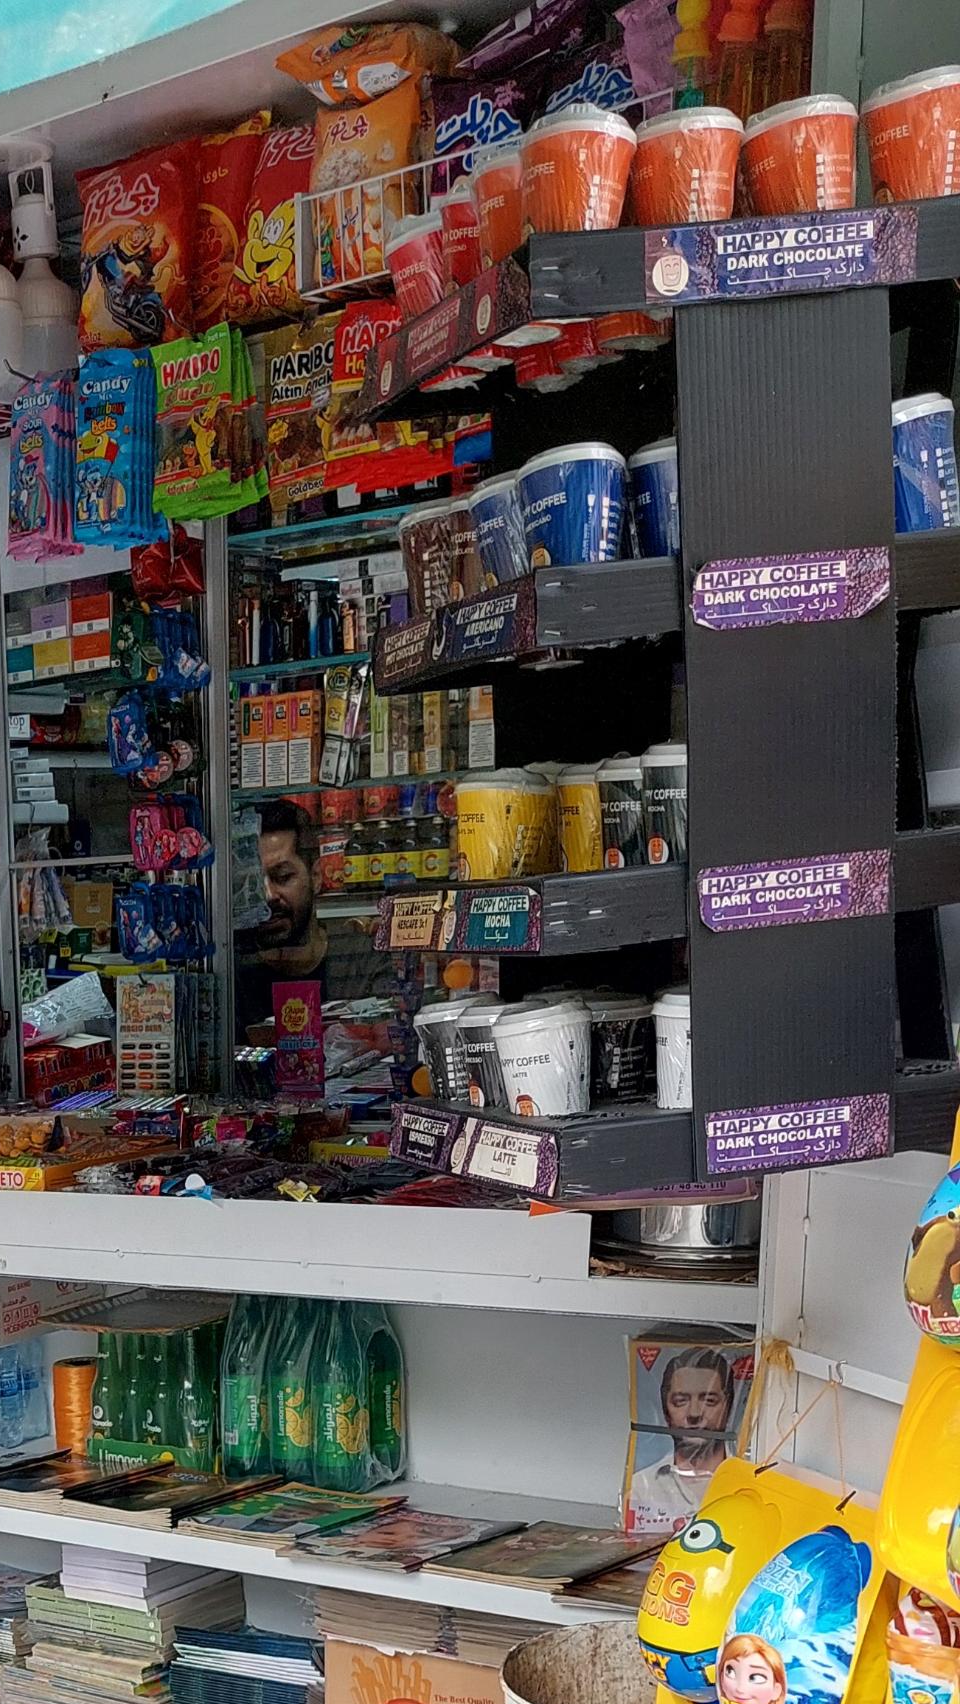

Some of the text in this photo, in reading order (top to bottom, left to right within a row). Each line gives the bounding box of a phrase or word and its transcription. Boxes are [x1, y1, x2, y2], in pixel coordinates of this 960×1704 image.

[722, 222, 869, 254] HAPPY COFFEE
[727, 244, 864, 271] DARK CHOCOLATE
[835, 260, 865, 278] دارک
[82, 376, 132, 395] Candy
[12, 393, 54, 412] Candy
[530, 491, 567, 514] COFFEE
[701, 562, 841, 590] HAPPY COFFEE
[704, 582, 838, 606] DARK CHOCOLATE
[807, 597, 838, 612] دارک
[464, 616, 505, 638] AMERICANO
[654, 788, 688, 801] COFFEE
[609, 801, 641, 812] COFFEE
[707, 864, 845, 894] HAPPY COFFEE
[472, 895, 527, 913] HAPPY COFFEE
[711, 882, 842, 910] DARK CHOCOLATE
[814, 898, 842, 912] دارک
[484, 914, 511, 928] MOCHA
[468, 1041, 496, 1053] COFFEE
[516, 1053, 551, 1068] COFFEE
[402, 1114, 448, 1136] HAPPY COFFEE
[713, 1108, 846, 1136] HAPPY COFFEE
[480, 1132, 538, 1153] HAPPY COFFEE
[716, 1125, 842, 1151] DARK CHOCOLATE
[814, 1141, 842, 1154] دارک
[492, 1151, 517, 1167] LATTE
[433, 1694, 448, 1702] The
[449, 1695, 466, 1704] Best
